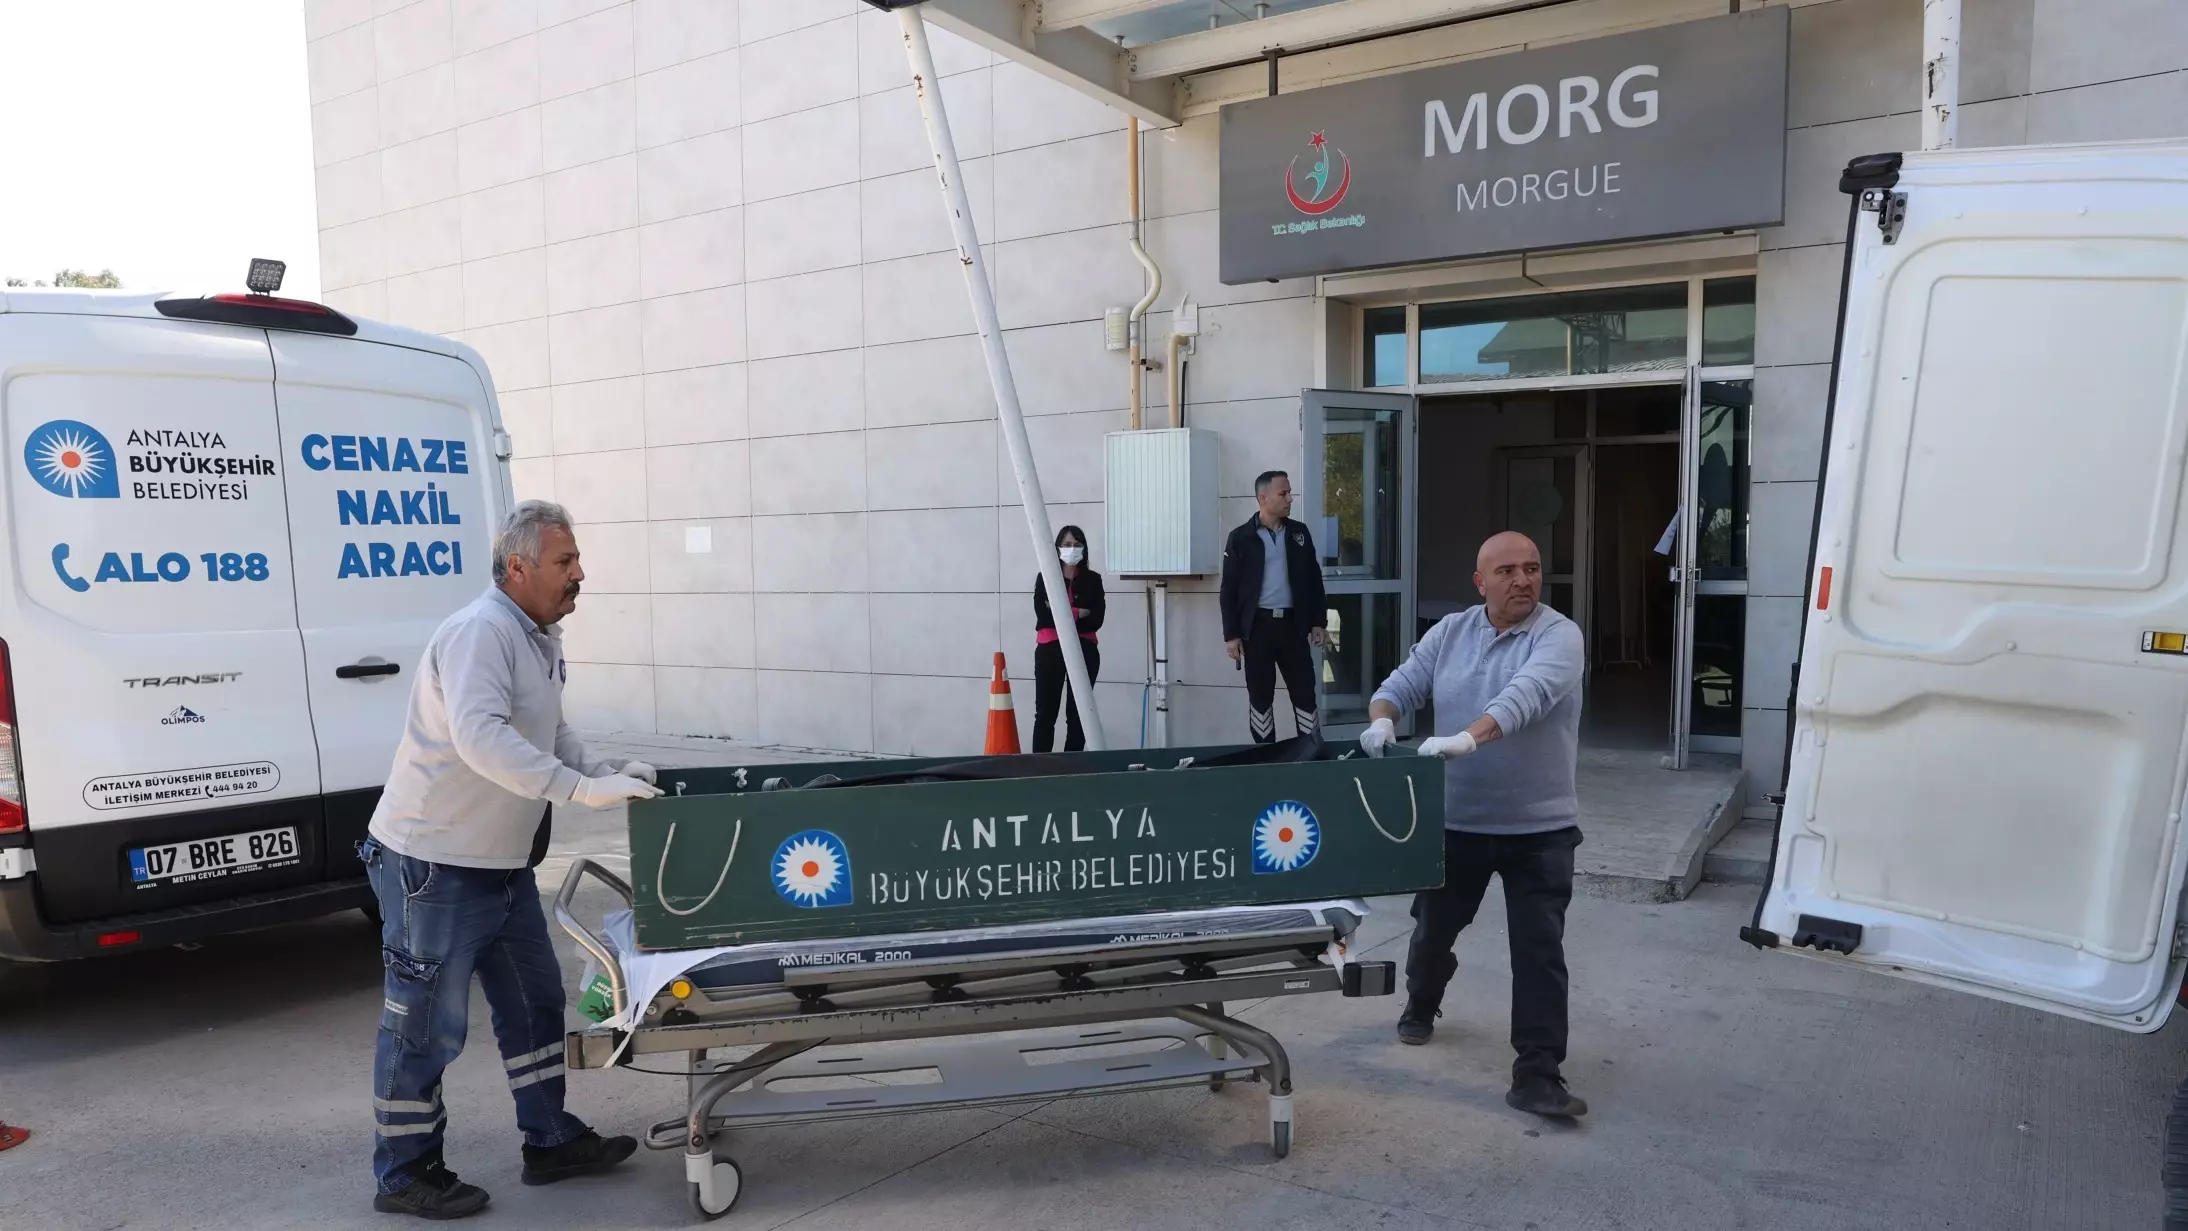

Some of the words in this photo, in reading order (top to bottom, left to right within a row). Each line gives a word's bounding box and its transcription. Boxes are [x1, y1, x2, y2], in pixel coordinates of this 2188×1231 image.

[1424, 64, 1659, 158] MORG
[1457, 162, 1621, 212] MORGUE
[127, 429, 226, 448] ANTALYA
[129, 451, 276, 479] BÜYÜKŞEHİR
[301, 433, 469, 474] CENAZE
[133, 478, 248, 500] BELEDİYESİ
[336, 482, 461, 525] NAKİL
[94, 552, 191, 582] ALO
[200, 552, 270, 582] 188
[337, 540, 463, 579] ARACI
[123, 671, 243, 688] TRANSIT
[161, 715, 205, 725] OLİMPOS
[92, 780, 142, 792] ANTALYA
[145, 772, 212, 787] BÜYÜKŞEHİR
[215, 766, 271, 780] BELEDİYESİ
[104, 792, 152, 805] İLETİŞİM
[155, 786, 201, 799] MERKEZİ
[212, 783, 230, 793] 444
[232, 782, 244, 791] 94
[247, 781, 258, 789] 20
[941, 807, 1156, 852] ANTALYA
[134, 867, 146, 875] TR
[146, 847, 177, 875] 07
[189, 838, 236, 869] BRE
[249, 831, 293, 860] 826
[198, 869, 227, 880] CEYLAN
[875, 951, 912, 962] 2000
